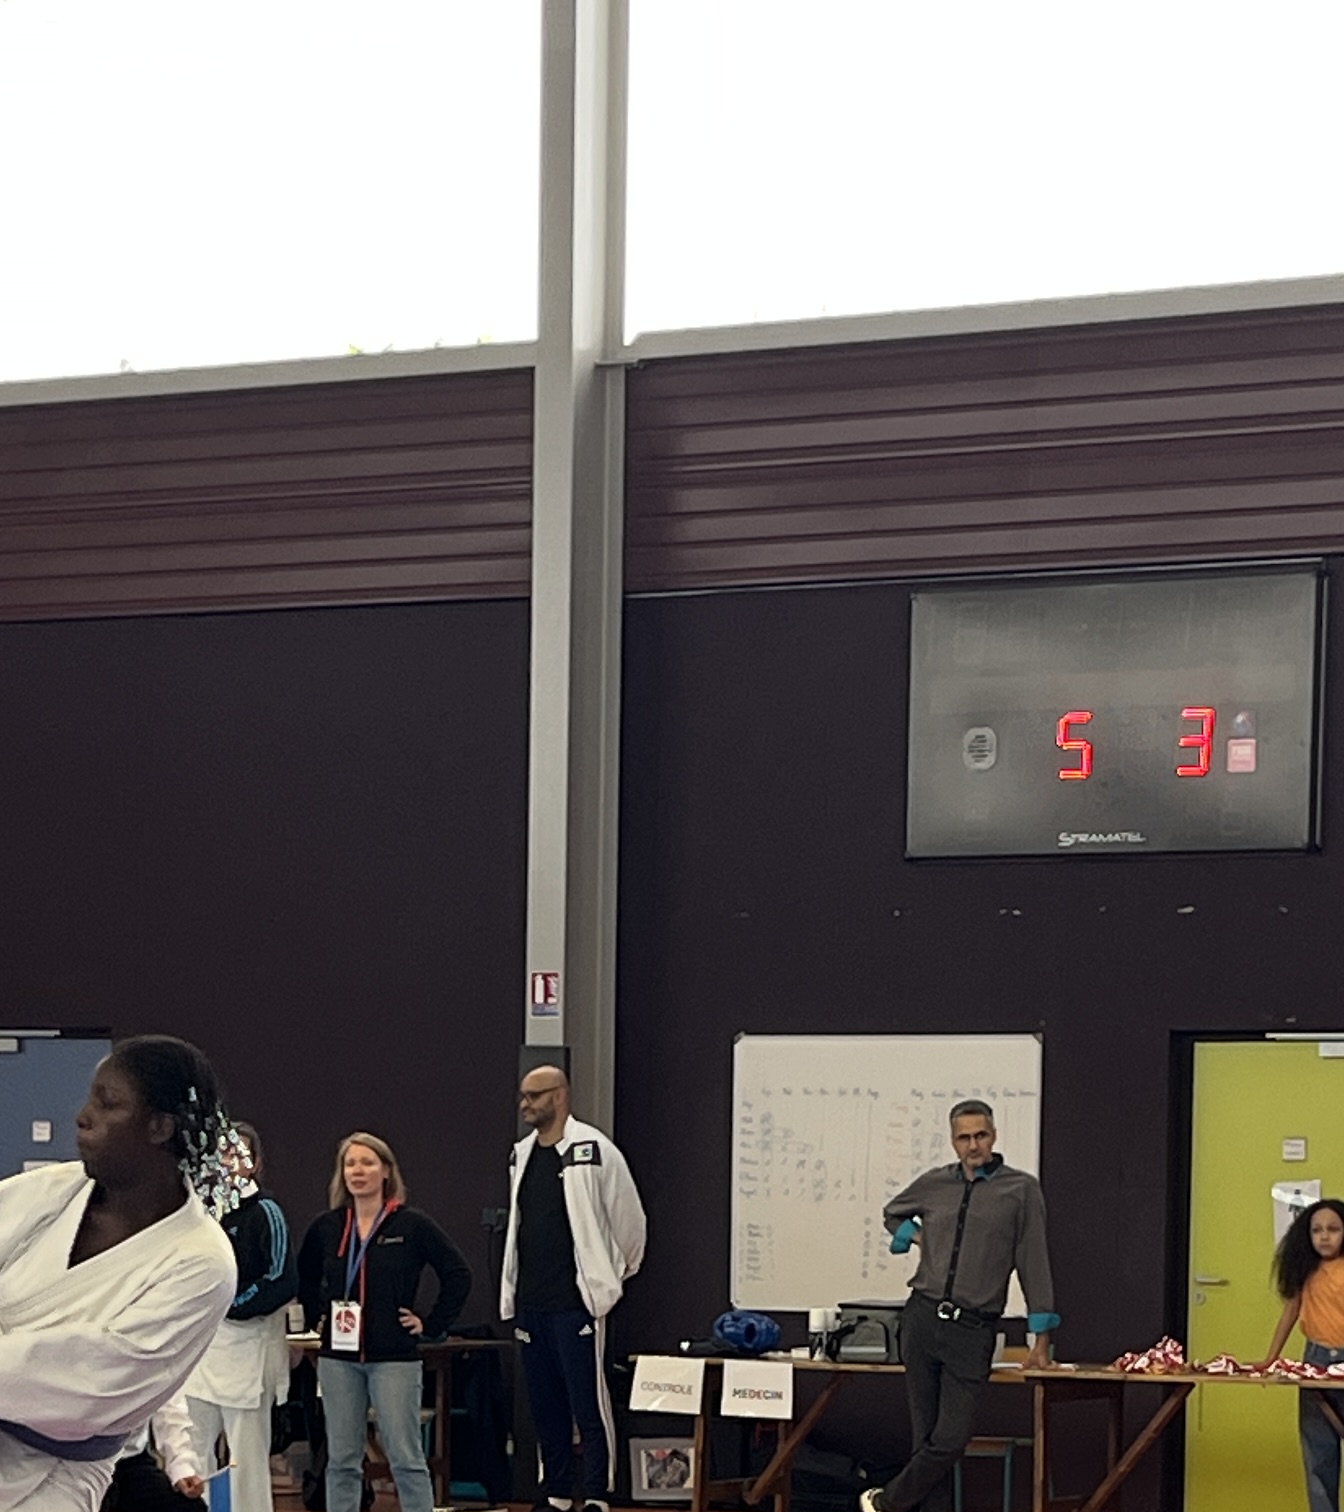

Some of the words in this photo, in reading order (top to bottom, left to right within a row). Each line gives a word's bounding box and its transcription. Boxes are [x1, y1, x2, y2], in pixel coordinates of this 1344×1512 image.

[1055, 711, 1094, 780] 5
[1175, 706, 1216, 777] 3
[1058, 832, 1146, 847] STRAMATEL
